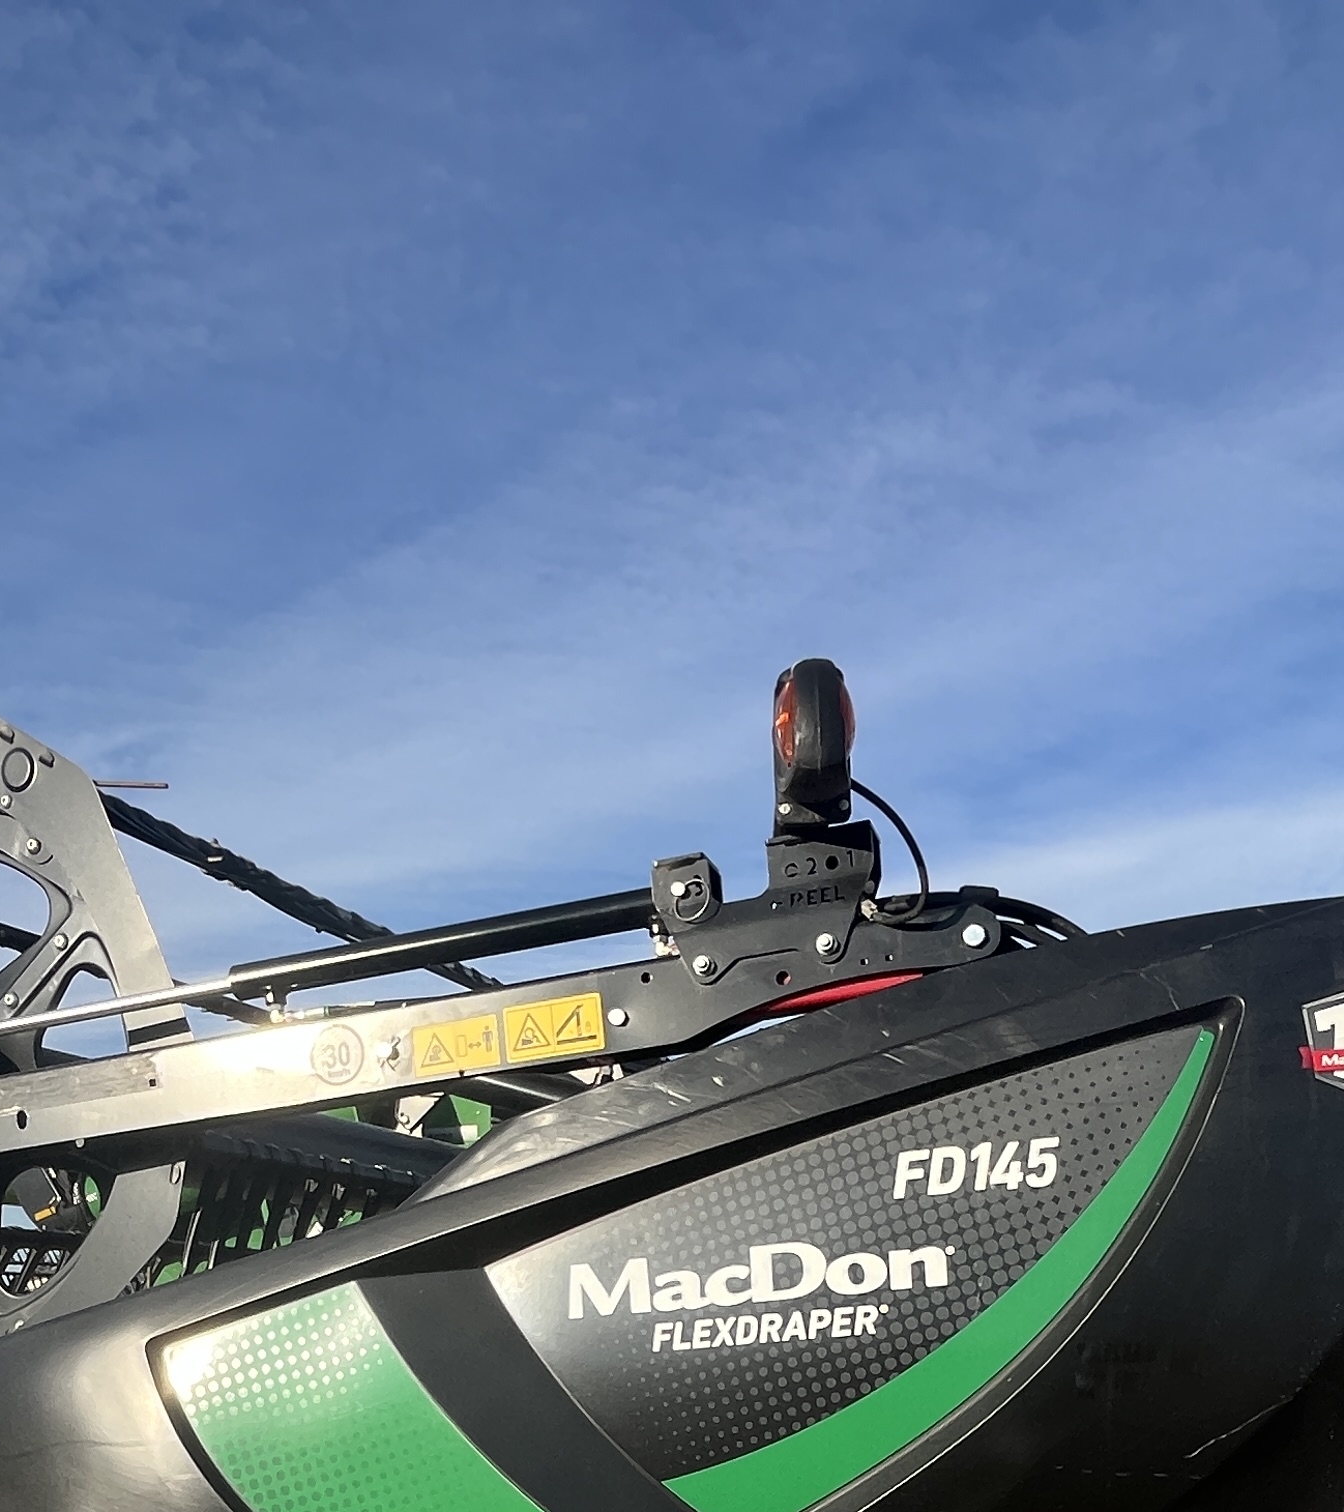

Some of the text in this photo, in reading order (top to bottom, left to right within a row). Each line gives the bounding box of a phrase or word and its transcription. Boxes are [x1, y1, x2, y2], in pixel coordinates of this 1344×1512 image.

[805, 857, 817, 876] 2
[318, 1040, 351, 1070] 30
[892, 1136, 1061, 1200] FD145
[567, 1241, 951, 1320] MacDon
[651, 1305, 882, 1353] FLEXDRAPER
